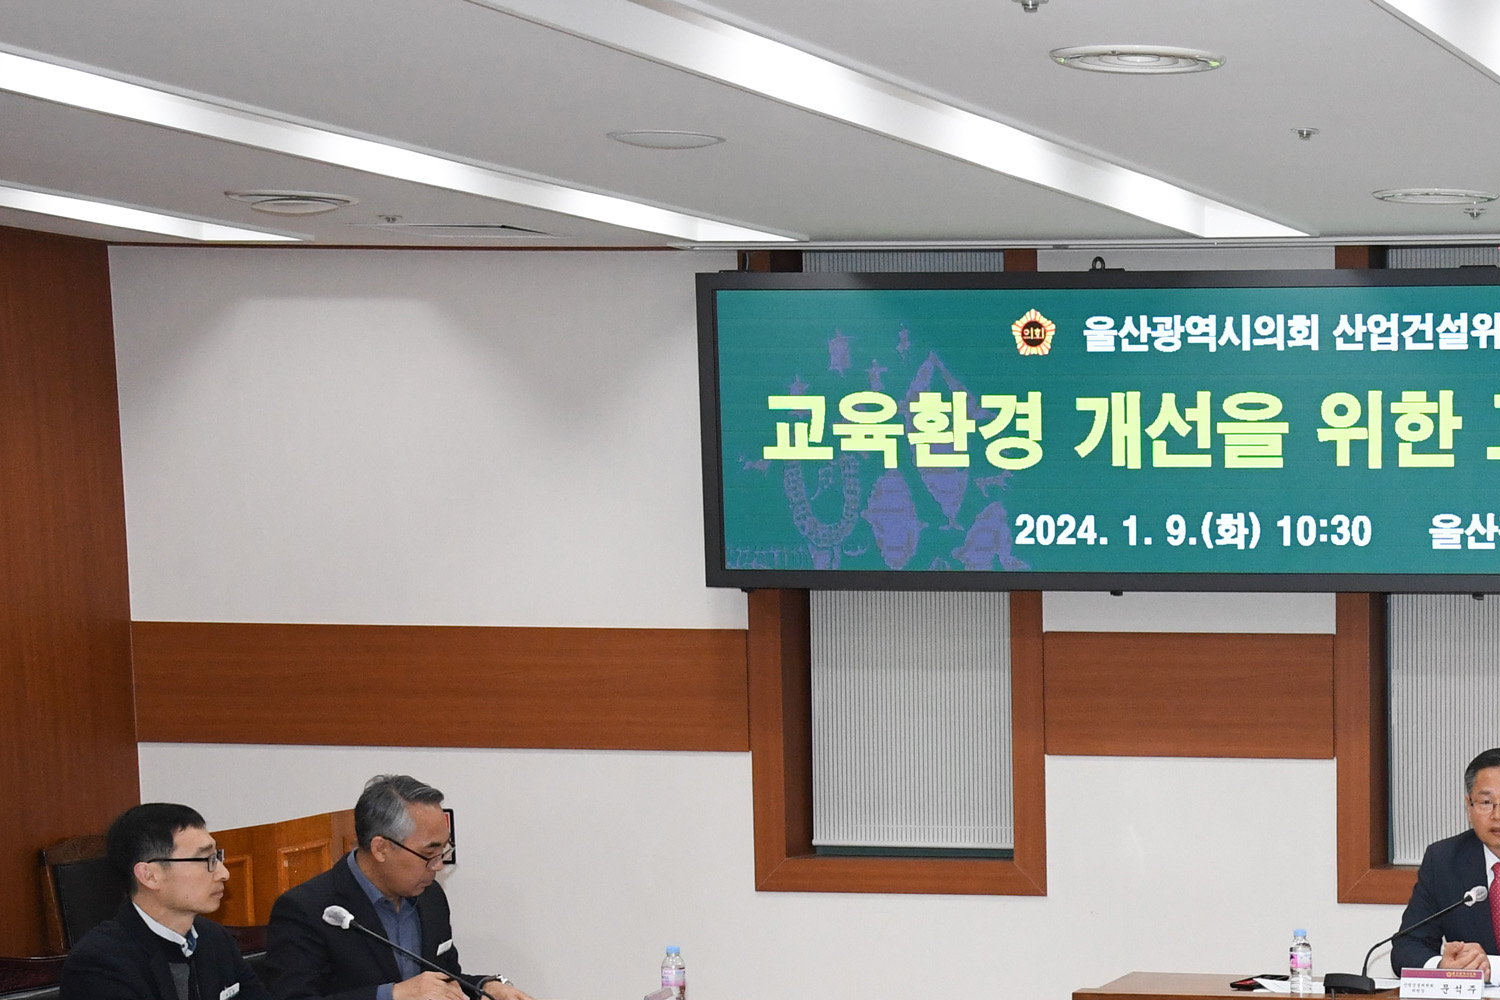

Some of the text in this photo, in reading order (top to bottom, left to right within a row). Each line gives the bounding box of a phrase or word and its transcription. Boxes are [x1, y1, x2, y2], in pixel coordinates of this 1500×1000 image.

[1084, 314, 1318, 352] 울산광역시의회
[764, 392, 1042, 469] 교육환경
[1075, 391, 1288, 469] 개선을
[1317, 390, 1462, 468] 위한
[1016, 511, 1371, 549] 2024. 1. 9.(화) 10:30
